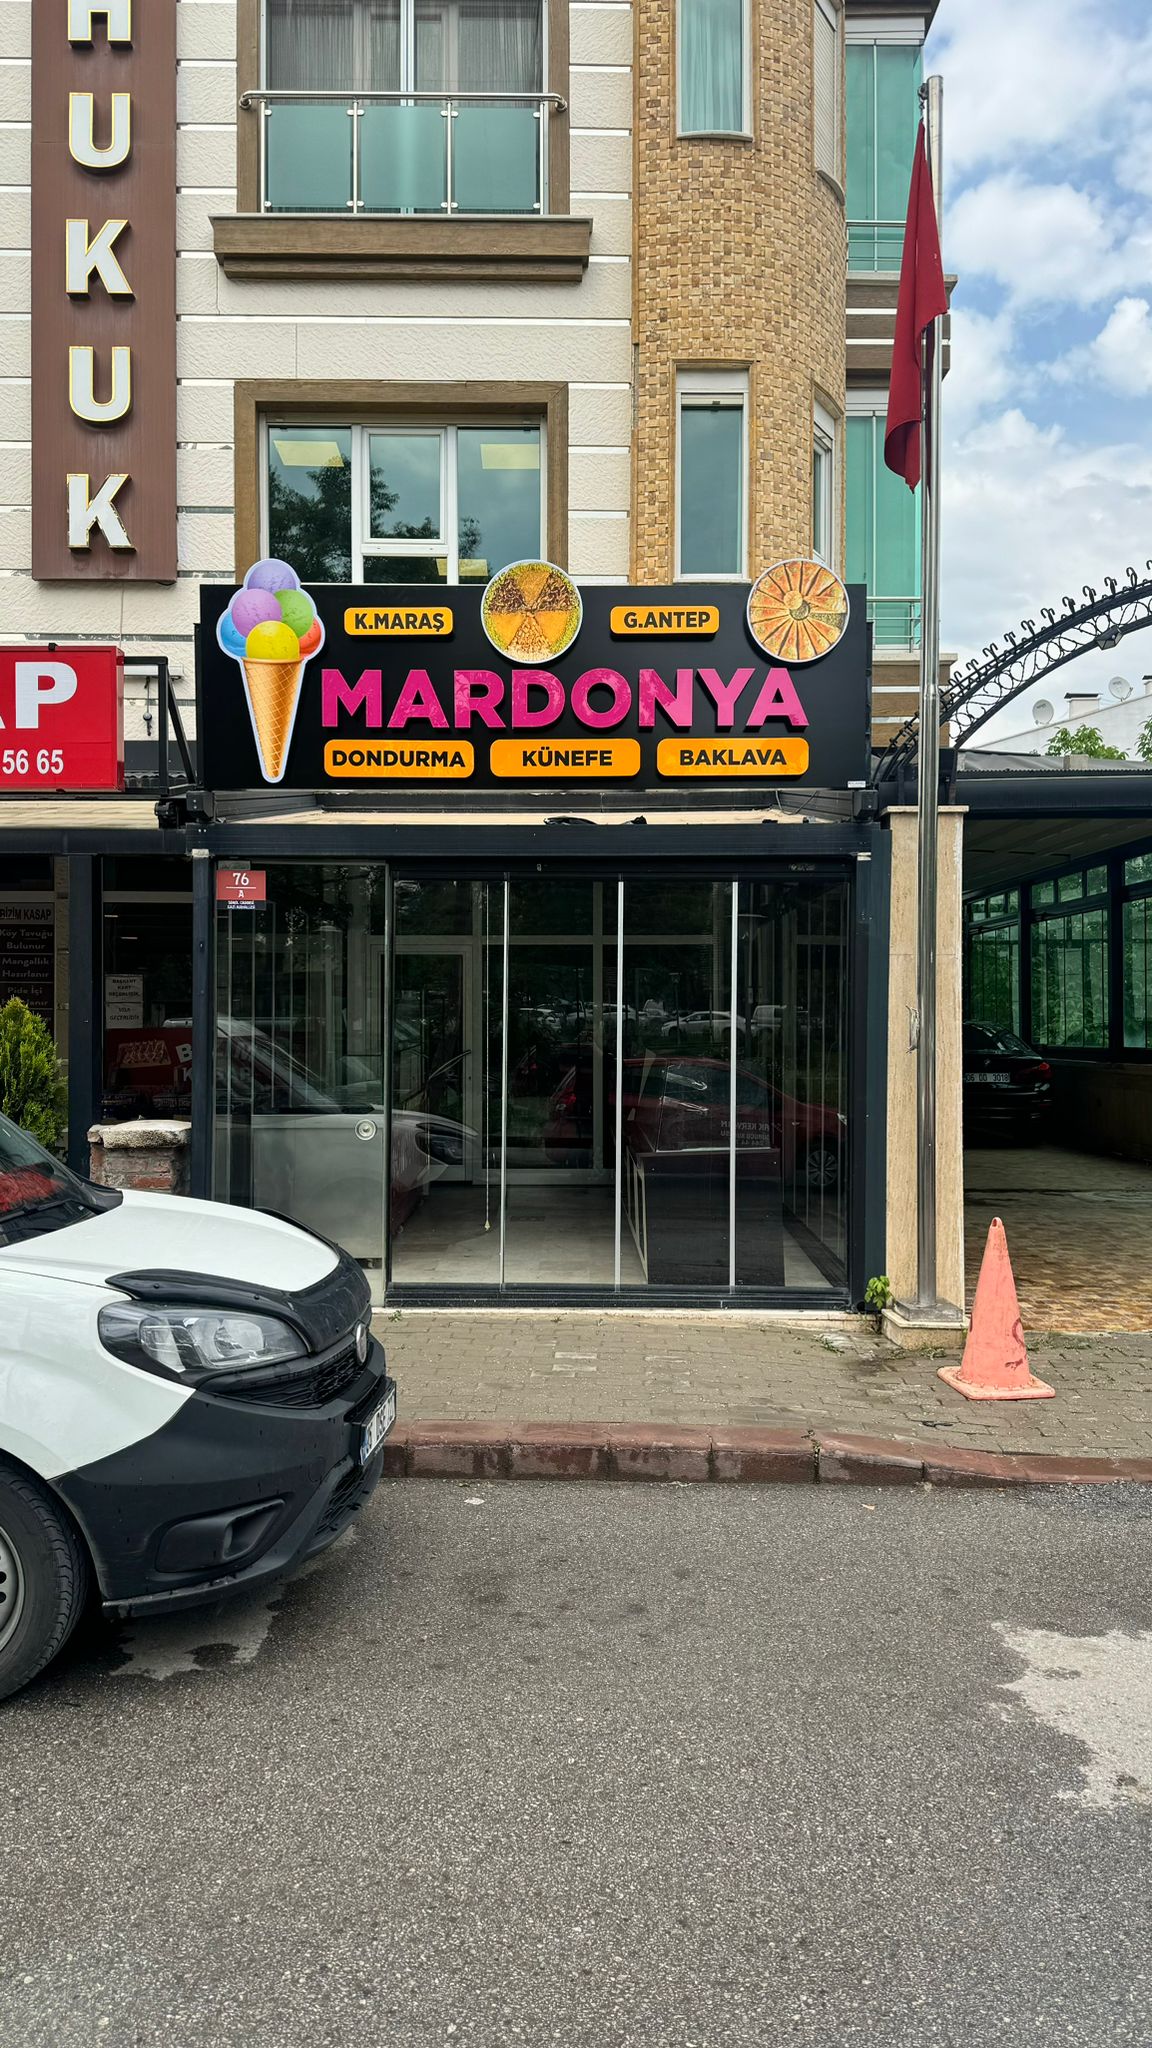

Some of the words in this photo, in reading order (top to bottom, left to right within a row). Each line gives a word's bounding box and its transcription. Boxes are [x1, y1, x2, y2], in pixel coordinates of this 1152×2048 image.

[354, 611, 445, 635] K.MARAŞ
[623, 611, 711, 630] G.ANTEP
[0, 661, 78, 729] P
[321, 668, 810, 730] MARDONYA
[2, 749, 29, 775] 56
[36, 749, 64, 775] 65
[332, 748, 466, 769] DONDURMA
[522, 745, 613, 767] KÜNEFE
[679, 748, 787, 767] BAKLAVA
[232, 872, 249, 886] 76
[238, 889, 245, 898] A
[23, 908, 51, 921] KASAP
[0, 928, 18, 939] Köy
[18, 928, 53, 940] Tavuğu
[6, 941, 47, 950] Bulunur
[2, 956, 49, 968] Mangallık
[2, 969, 49, 979] Hazırlanır
[7, 986, 28, 994] Pide
[31, 984, 43, 996] İçi
